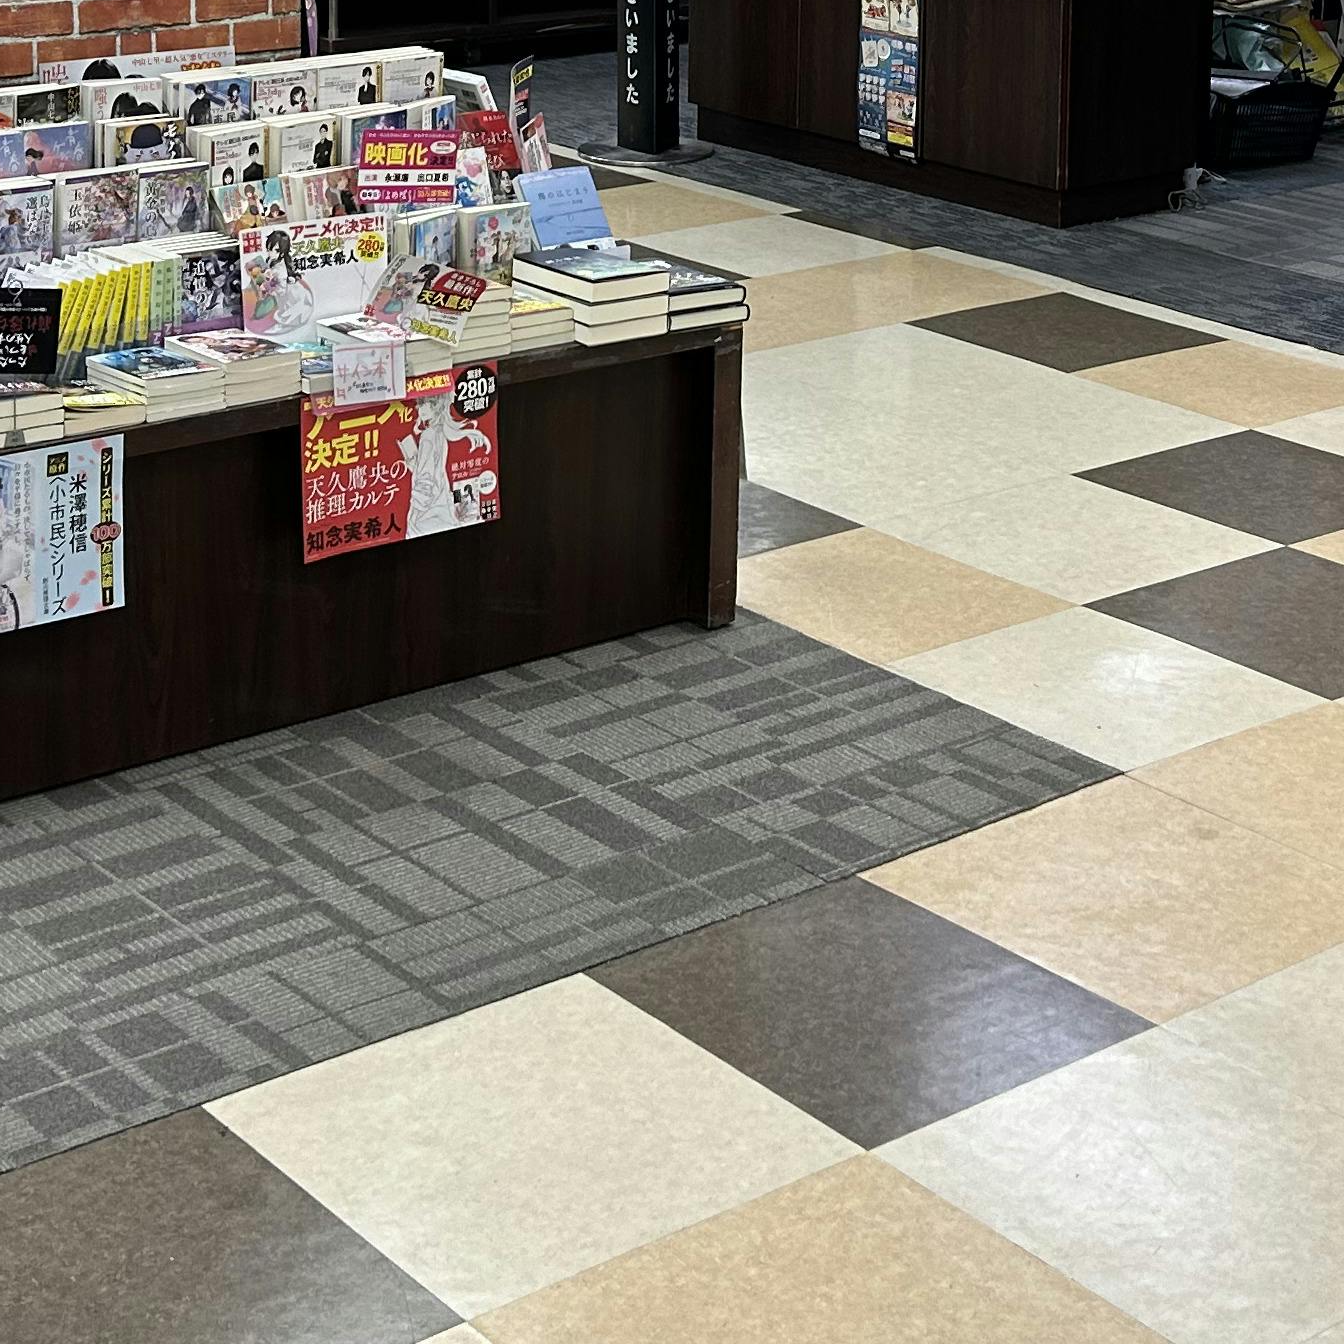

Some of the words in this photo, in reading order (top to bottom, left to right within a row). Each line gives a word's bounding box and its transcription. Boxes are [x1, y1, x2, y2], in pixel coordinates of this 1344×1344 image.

[363, 141, 429, 167] 映画化
[290, 215, 385, 241] アニメ化決定!!
[293, 251, 359, 272] 知念実希人
[419, 289, 475, 312] 天久鷹央
[406, 373, 451, 392] メ化決定!!
[304, 428, 380, 474] 決定!!
[306, 460, 407, 499] 天久鷹央の
[68, 471, 89, 555] 米澤穂信
[306, 486, 400, 525] 推理カルテ
[48, 475, 68, 617] 〈小市民〉シリーズ
[306, 513, 402, 554] 知念実希人
